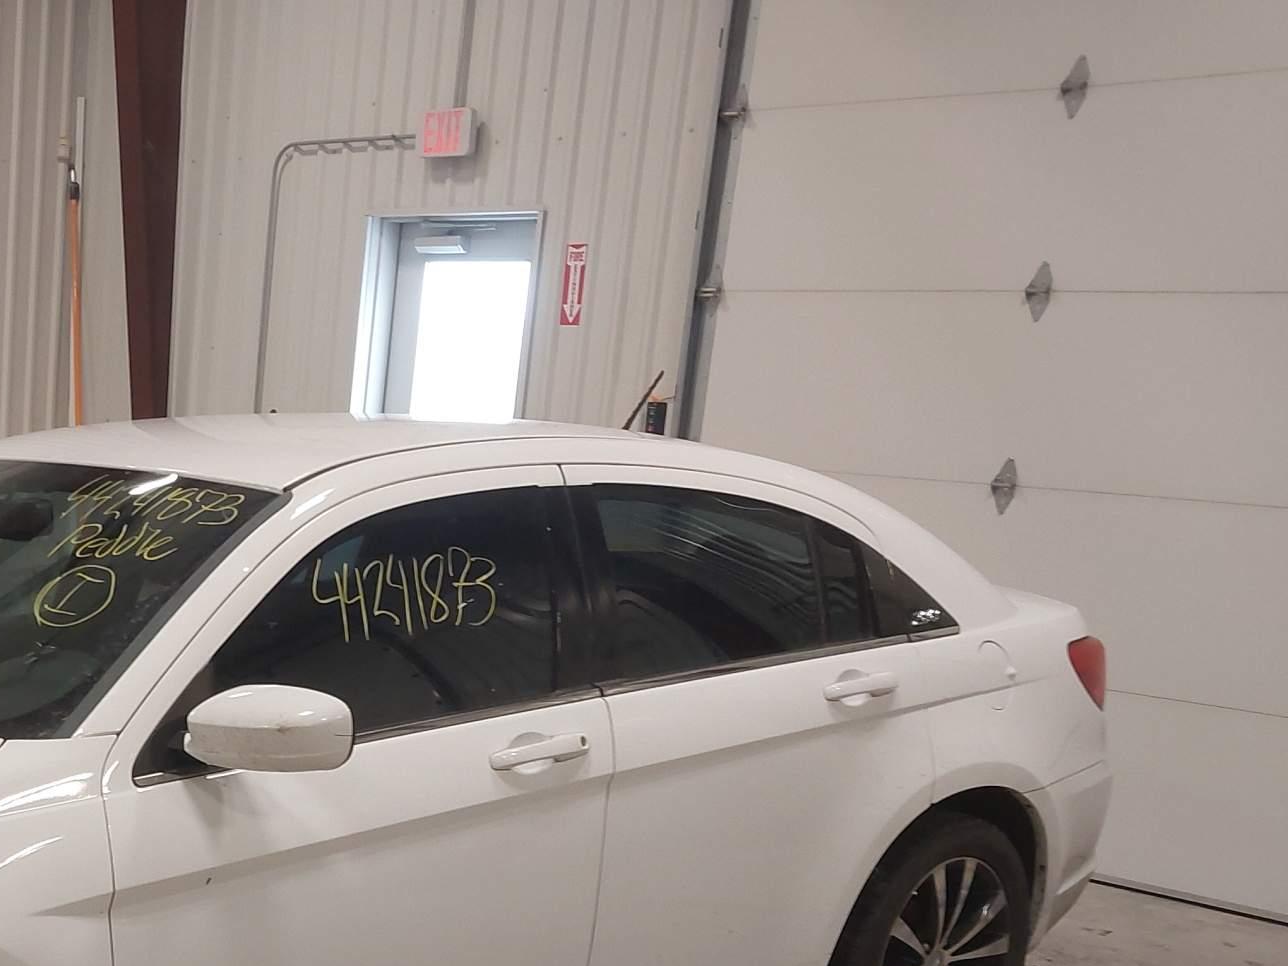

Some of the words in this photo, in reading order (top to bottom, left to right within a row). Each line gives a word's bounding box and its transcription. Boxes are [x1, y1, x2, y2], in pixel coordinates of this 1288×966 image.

[423, 109, 464, 154] EXIT
[60, 474, 246, 526] 44241873
[312, 546, 497, 643] 44241873
